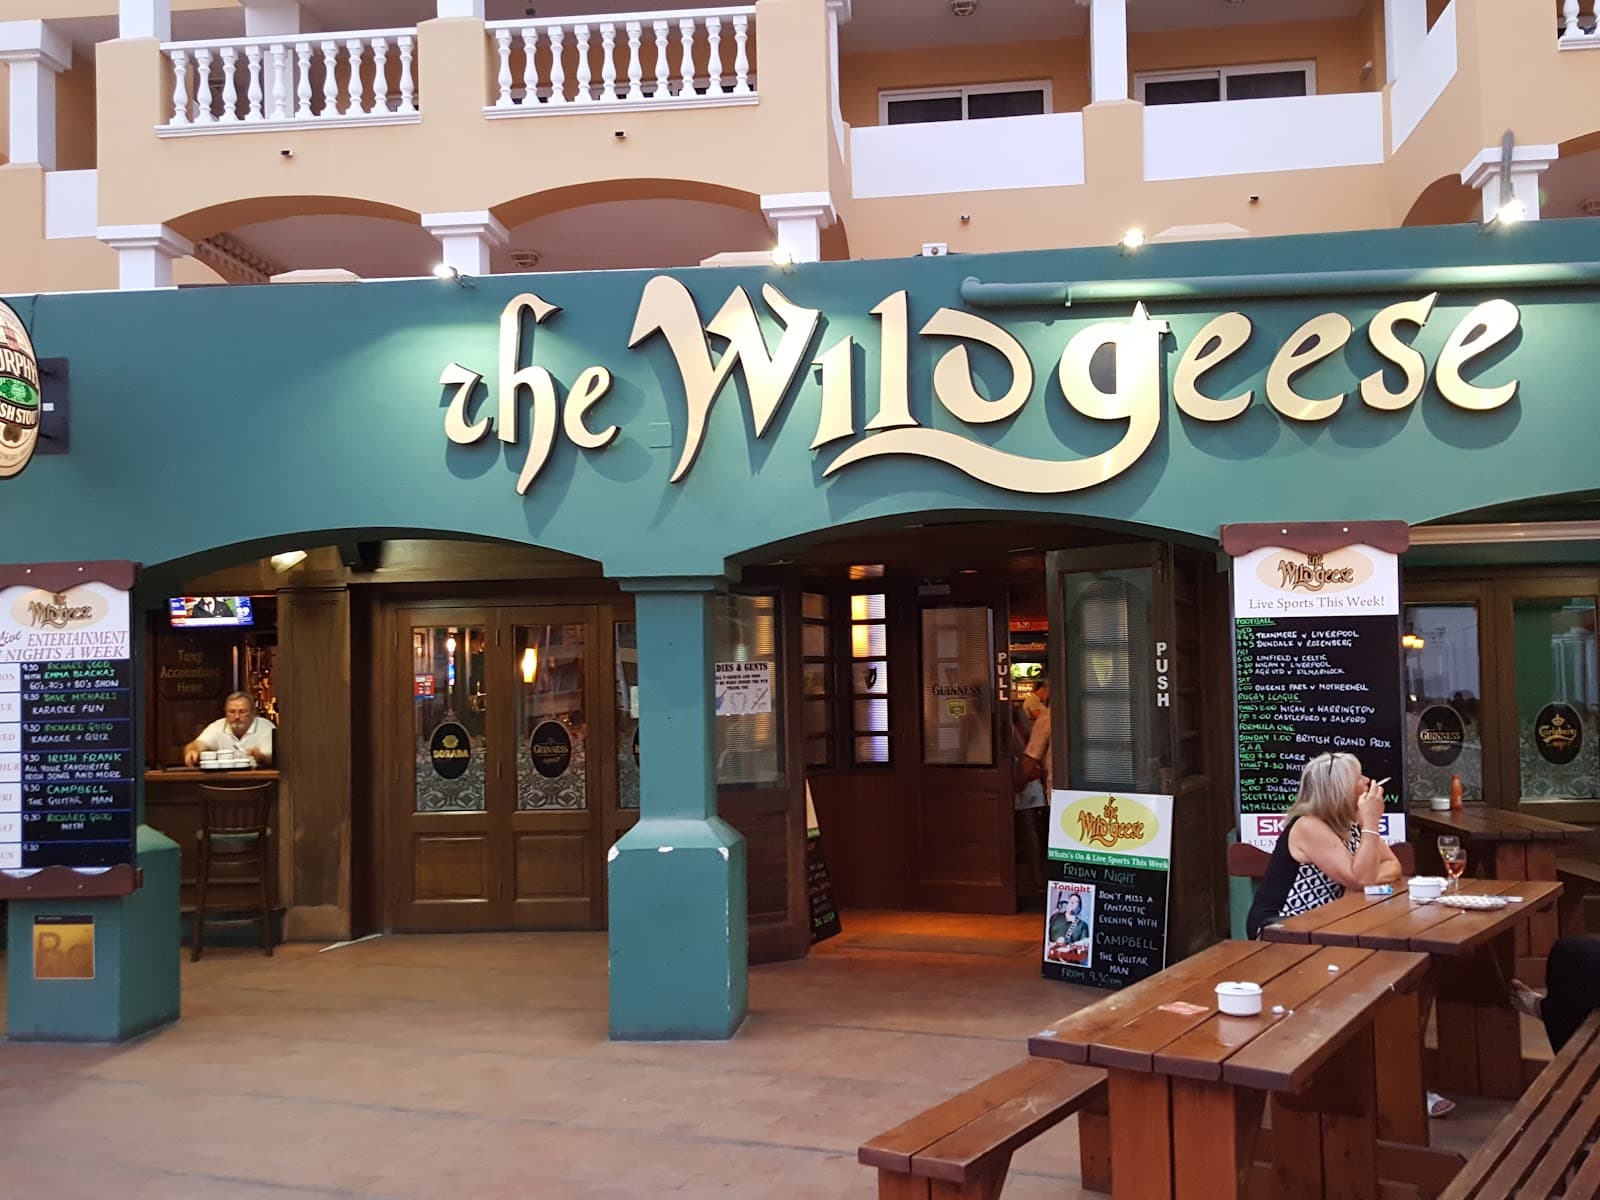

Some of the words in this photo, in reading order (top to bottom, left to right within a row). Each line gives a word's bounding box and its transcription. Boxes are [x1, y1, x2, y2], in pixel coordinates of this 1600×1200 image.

[439, 293, 621, 496] the
[1249, 598, 1274, 609] Live
[1276, 597, 1314, 611] Sports
[1316, 596, 1343, 608] This
[1346, 595, 1385, 607] Week!
[27, 631, 128, 647] ENTERTAINMENT
[1256, 631, 1297, 639] TRANMERE
[1311, 630, 1360, 638] LIVERPOOL
[1306, 639, 1352, 647] ROSENBERG
[5, 648, 62, 661] NIGHTS
[66, 647, 77, 659] A
[80, 646, 125, 658] WEEK
[715, 664, 734, 672] DIES
[43, 671, 69, 680] EMMA
[998, 652, 1008, 701] PULL
[1156, 642, 1170, 707] PUSH
[43, 694, 65, 702] DAVE
[1238, 693, 1264, 701] RUGBY
[1268, 692, 1300, 701] LEAGUE
[32, 705, 76, 714] KARAOKE
[82, 704, 105, 713] FUN
[1273, 714, 1320, 722] CASTLEFORD
[1330, 715, 1366, 723] SALFORD
[31, 734, 71, 743] KARAOKE
[85, 733, 109, 742] QUIZ
[1420, 729, 1461, 741] GUINNESS
[1296, 735, 1330, 744] BRITISH
[1334, 738, 1366, 747] GRAND
[1370, 738, 1391, 748] PRIX
[83, 753, 122, 762] FRANK
[64, 763, 110, 771] FAVOURITE
[46, 784, 108, 794] CAMPBELL
[1267, 784, 1297, 792] DUBLIN
[48, 796, 82, 805] GUITAR
[91, 796, 113, 804] MAN
[1242, 793, 1286, 801] SCOTTISH
[1259, 819, 1284, 832] SK
[1075, 852, 1084, 861] On
[1092, 854, 1106, 863] Live
[1108, 855, 1130, 866] Sports
[1132, 858, 1147, 867] This
[1149, 859, 1168, 869] Week
[1063, 864, 1096, 879] FRIDAY
[1104, 869, 1136, 884] NIGHT
[1052, 882, 1091, 893] Tonight
[1099, 890, 1121, 900] DON'T
[1125, 894, 1143, 903] MISS
[1104, 904, 1146, 915] FANTASTIC
[1099, 915, 1133, 926] EVENING
[1137, 918, 1157, 928] WITH
[1096, 932, 1158, 950] CAMPBELL
[1099, 952, 1113, 962] THE
[1118, 952, 1148, 965] GUITAR
[1061, 967, 1085, 979] FROM
[1109, 965, 1129, 976] MAN
